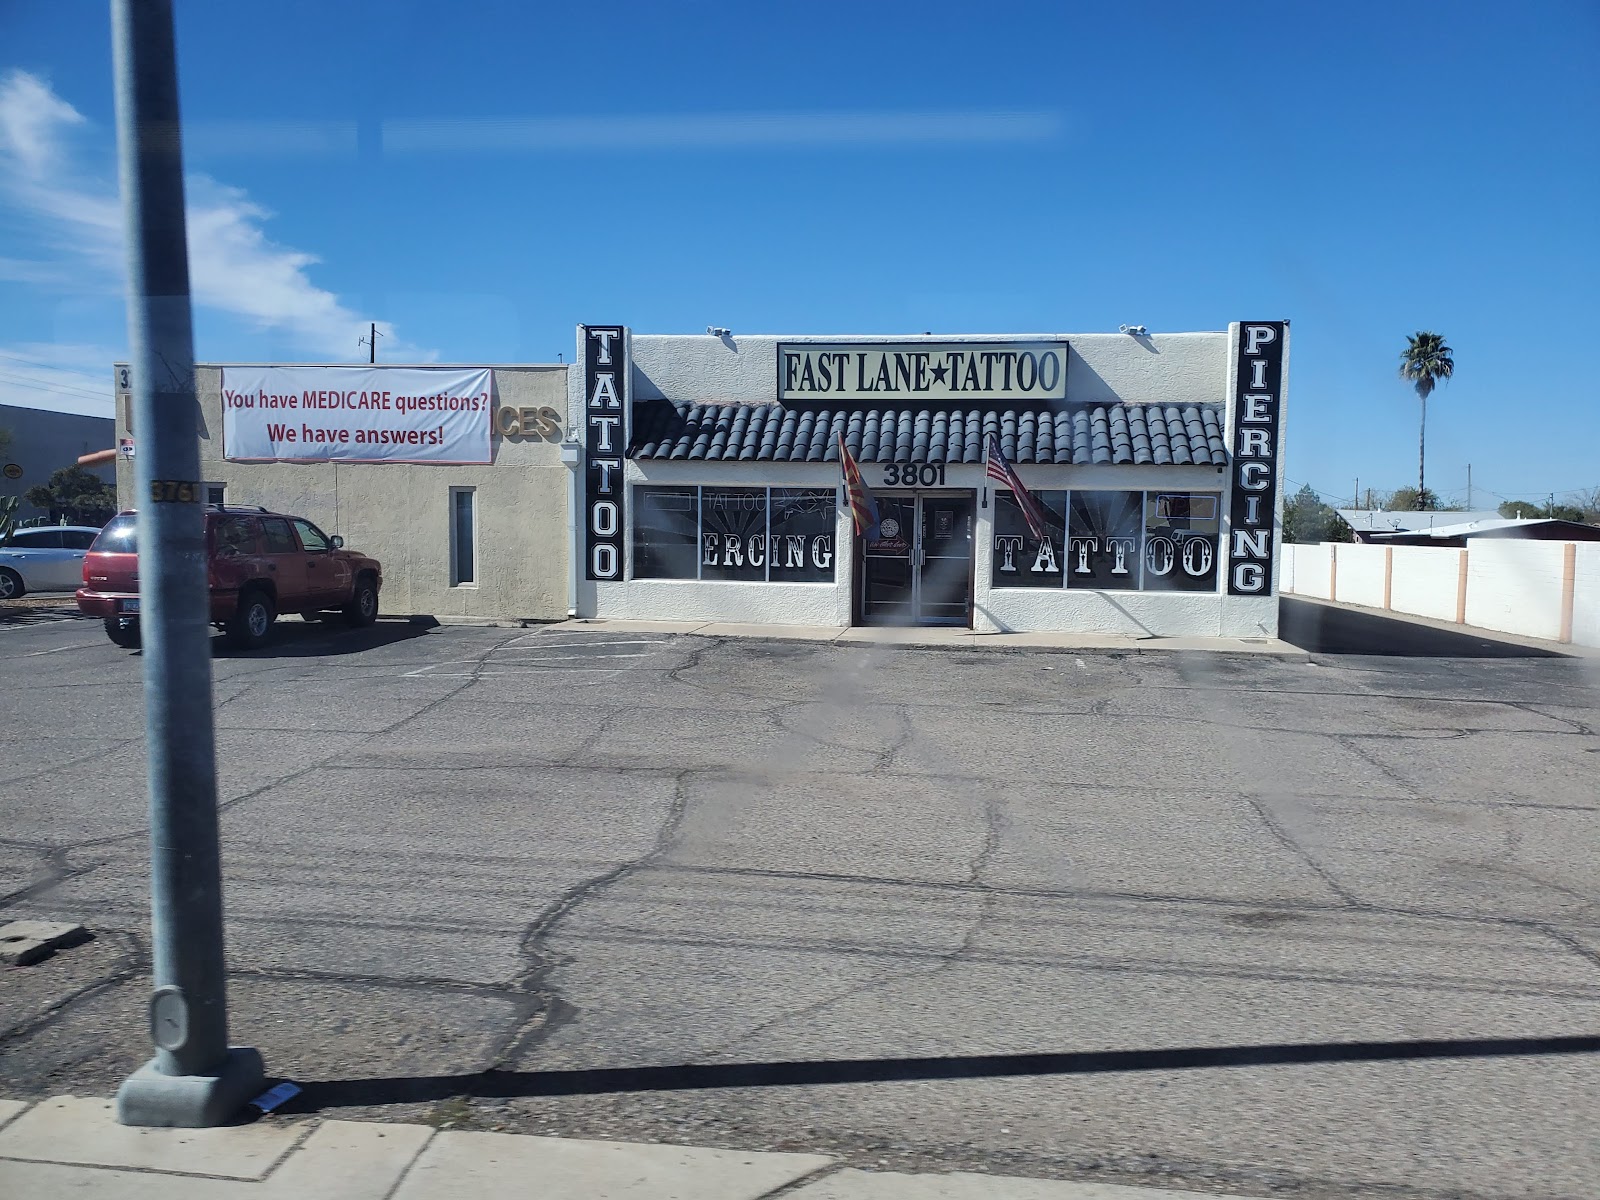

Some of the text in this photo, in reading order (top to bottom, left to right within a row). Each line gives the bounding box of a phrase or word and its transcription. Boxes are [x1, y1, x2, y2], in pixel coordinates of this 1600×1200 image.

[784, 351, 1060, 393] FAST LANE TATTOO
[225, 390, 488, 415] You have MEDICARE questions?
[267, 423, 444, 445] We have answers!
[588, 327, 621, 579] TATTOO
[883, 463, 946, 487] 3801
[1232, 325, 1277, 592] PIERCING
[994, 534, 1213, 576] TATTOO
